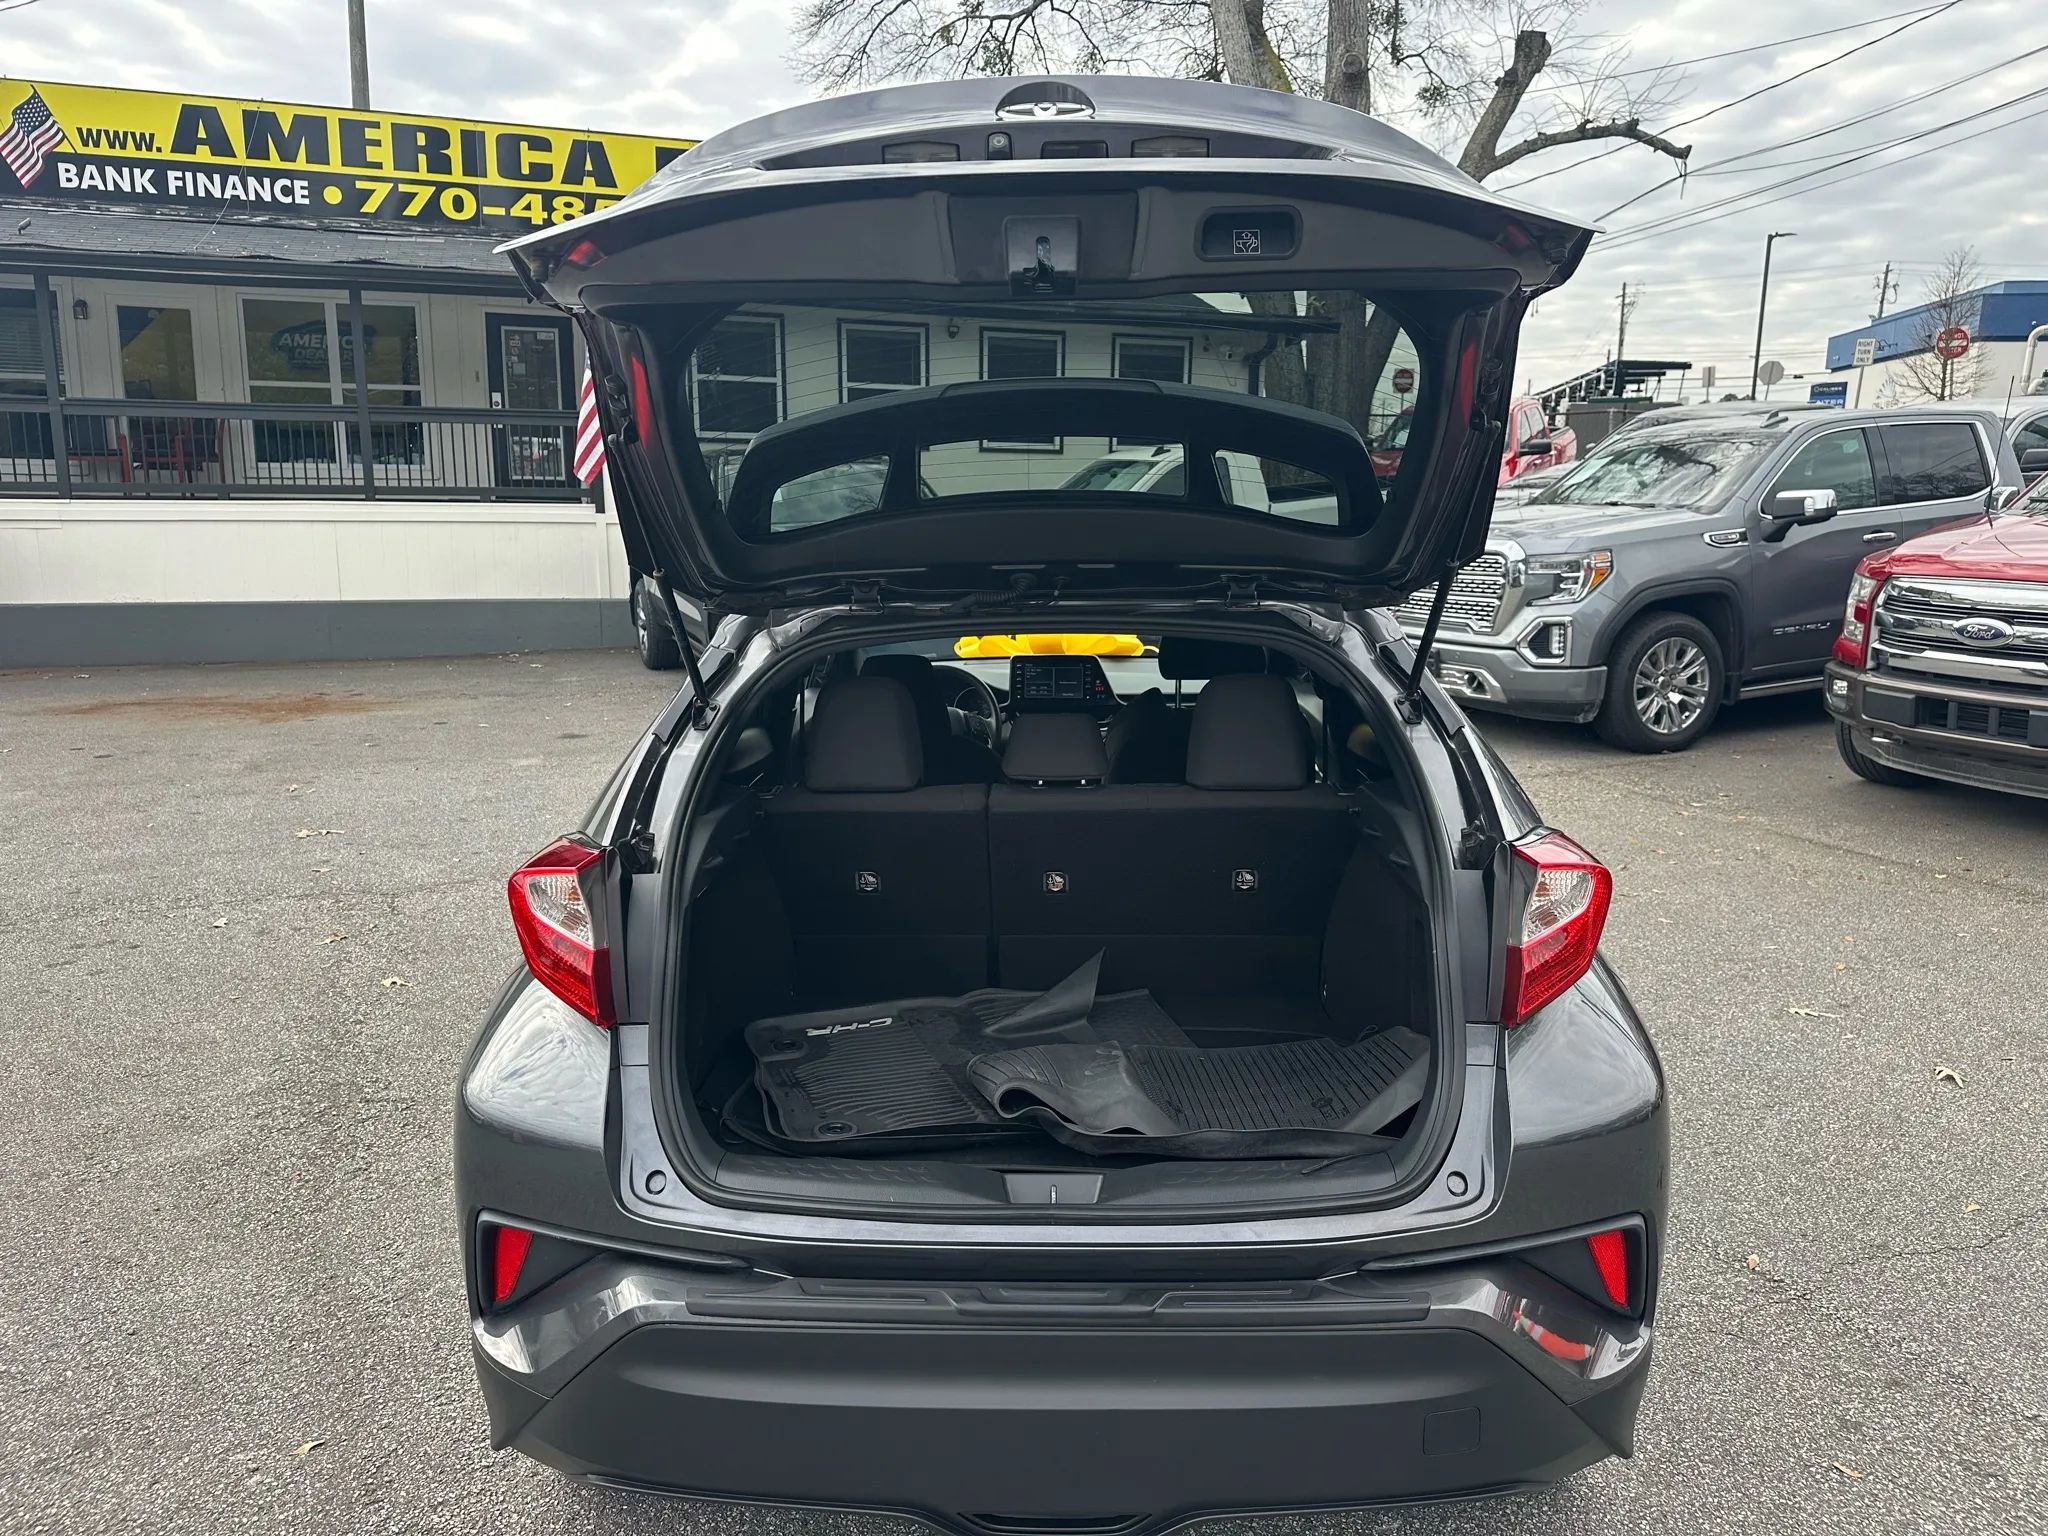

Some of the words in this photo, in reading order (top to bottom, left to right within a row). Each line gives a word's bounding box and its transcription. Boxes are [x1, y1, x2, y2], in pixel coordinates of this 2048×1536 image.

[170, 103, 618, 189] AMERICA
[57, 162, 158, 194] BANK
[166, 170, 310, 205] FINANCE
[1963, 624, 1996, 639] Ford
[805, 1017, 893, 1037] C-HR
